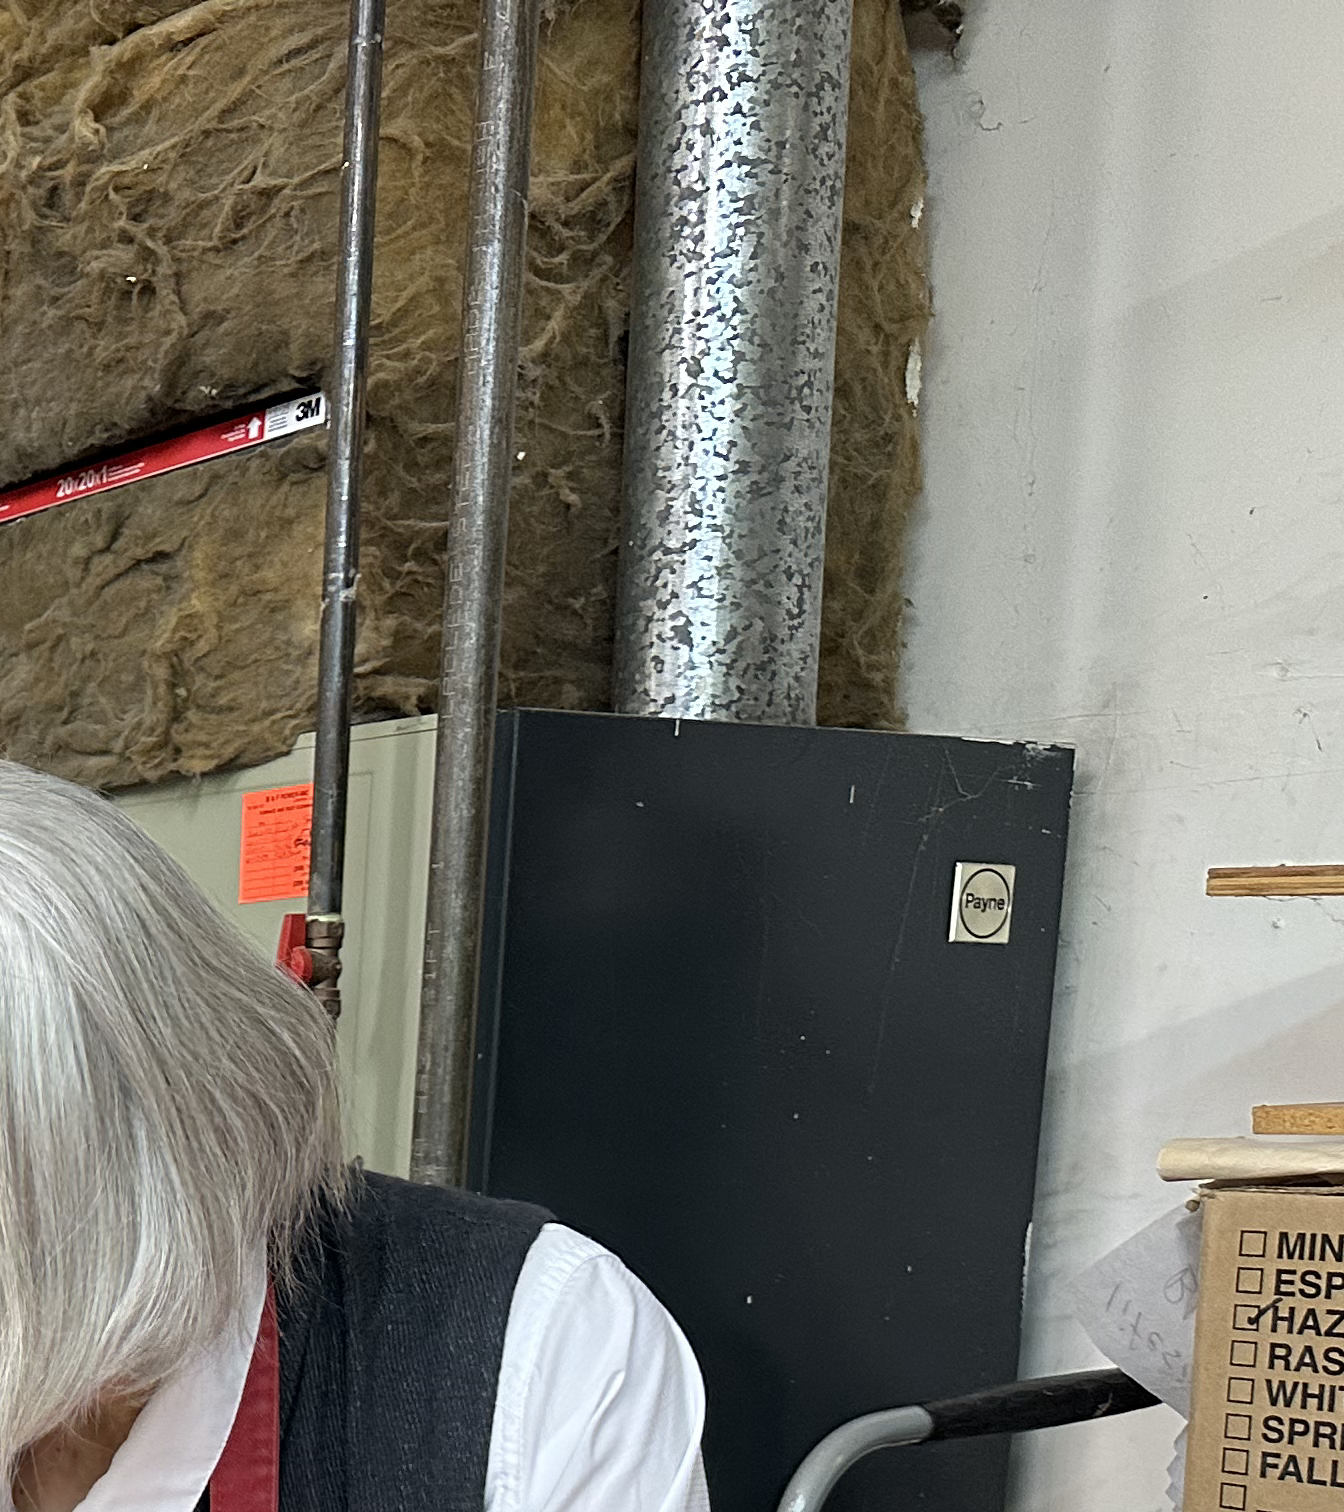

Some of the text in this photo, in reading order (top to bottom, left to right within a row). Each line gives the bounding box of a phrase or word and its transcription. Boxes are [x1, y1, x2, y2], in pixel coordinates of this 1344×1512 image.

[295, 397, 321, 422] 3M
[56, 464, 107, 498] 20x20x1
[965, 892, 1005, 913] Payne
[1265, 1378, 1344, 1413] WHI
